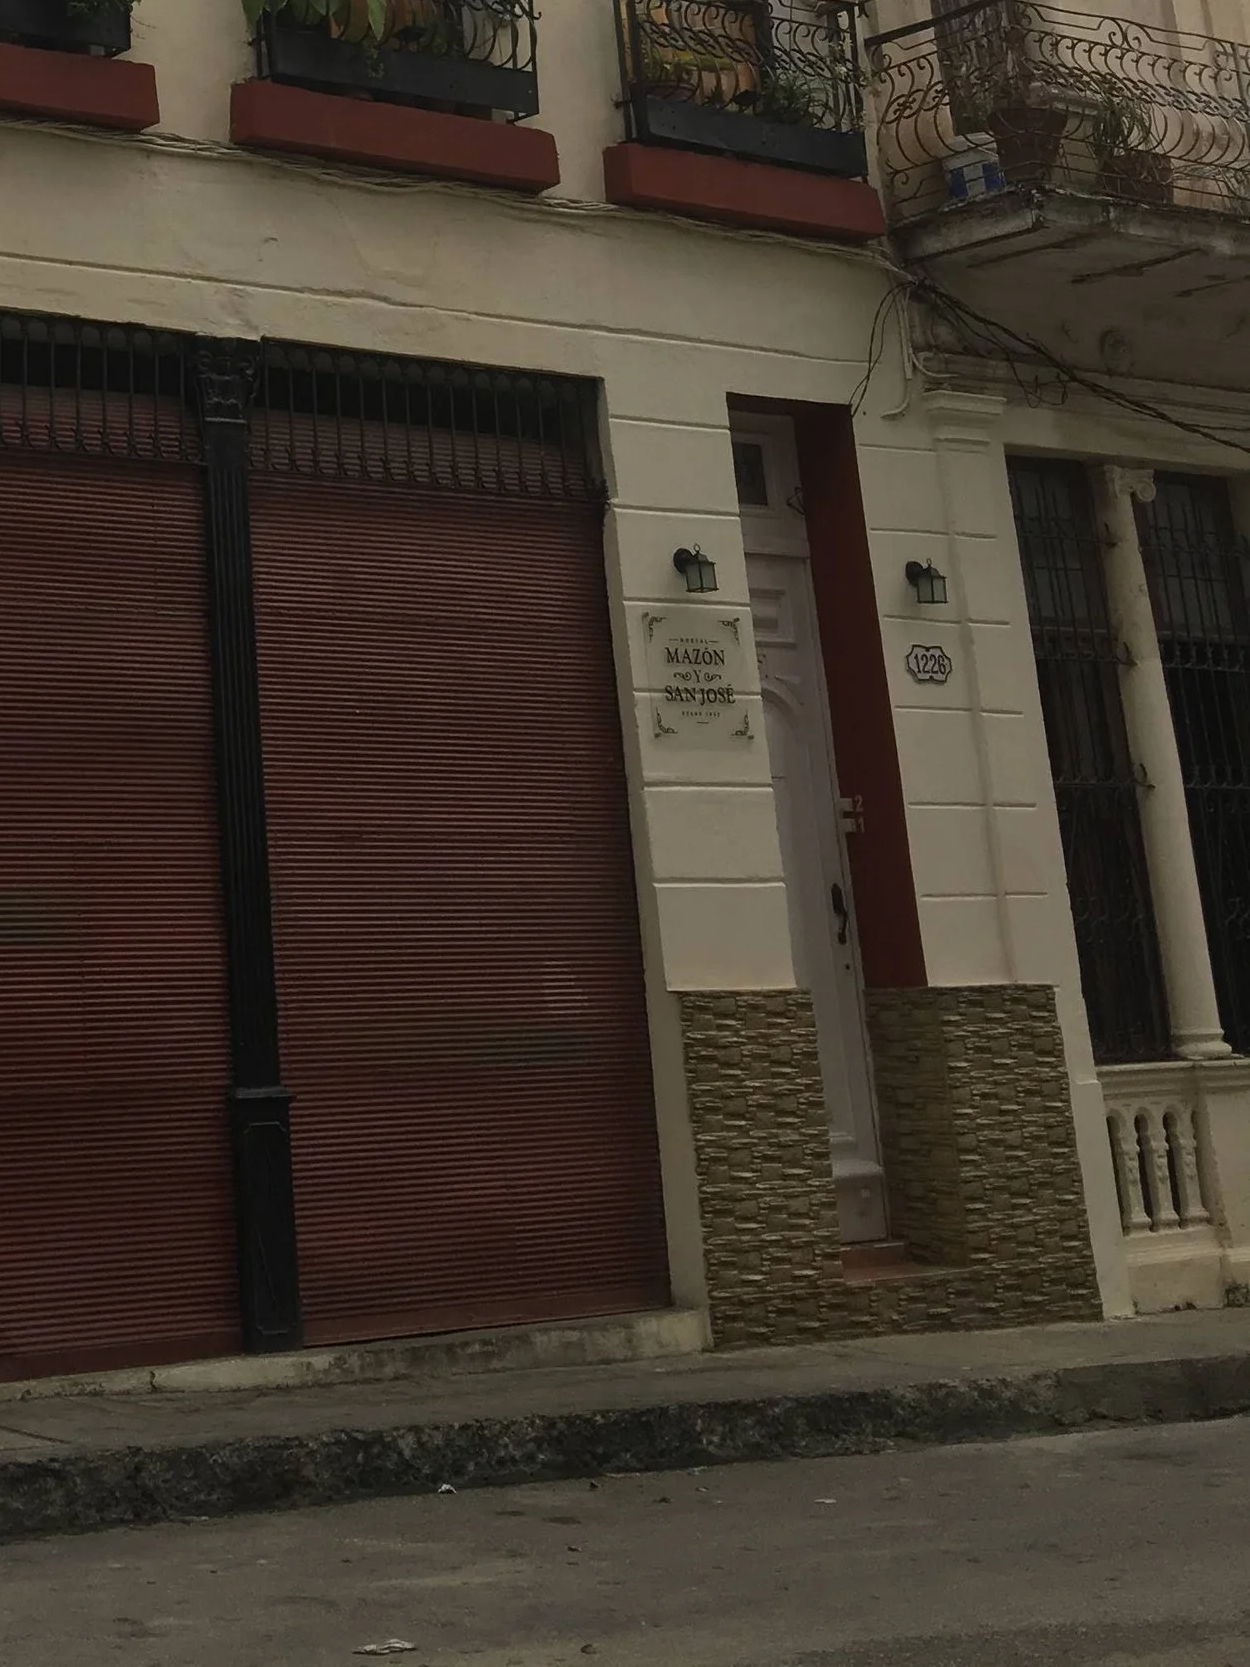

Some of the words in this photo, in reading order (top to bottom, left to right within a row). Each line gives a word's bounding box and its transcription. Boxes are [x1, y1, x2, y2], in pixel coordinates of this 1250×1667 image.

[665, 647, 725, 665] MAZÓN
[914, 653, 947, 675] 1226
[693, 670, 702, 683] Y
[665, 685, 697, 702] SAN
[699, 684, 736, 706] JOSÉ
